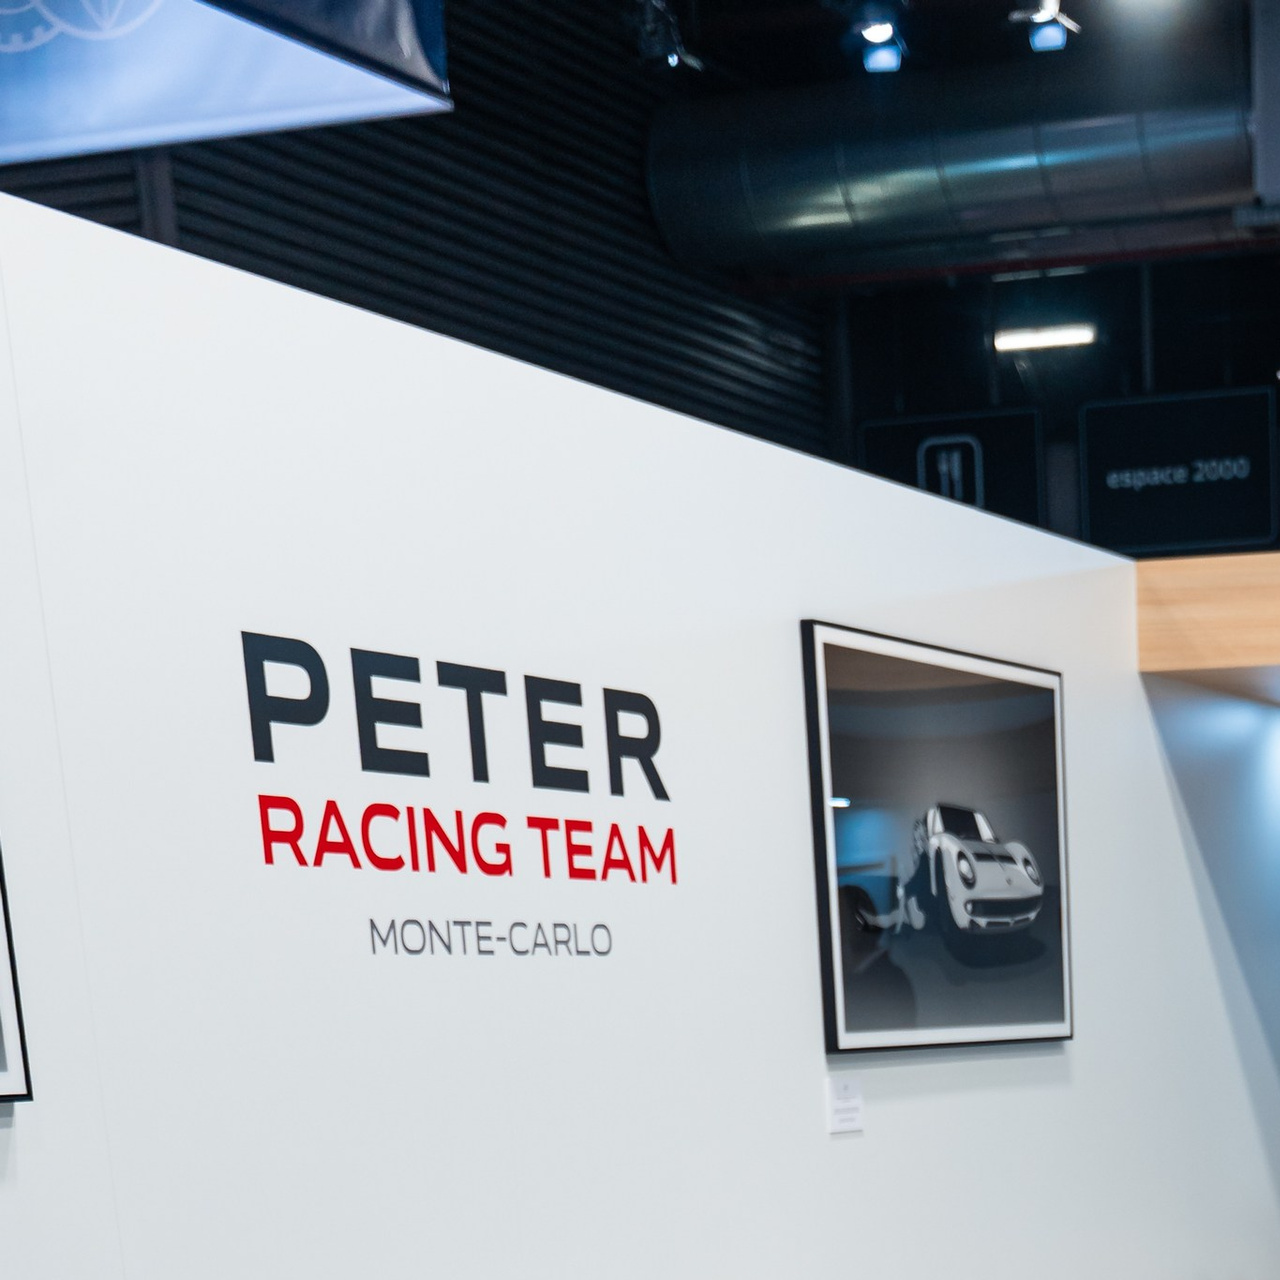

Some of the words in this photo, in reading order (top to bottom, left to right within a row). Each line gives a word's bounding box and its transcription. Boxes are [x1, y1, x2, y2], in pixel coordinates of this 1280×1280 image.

[1106, 466, 1189, 491] espace
[1192, 457, 1250, 482] 2000
[240, 630, 671, 802] PETER
[257, 794, 513, 877] RACING
[526, 815, 678, 885] TEAM
[369, 917, 612, 957] MONTE-CARLO
